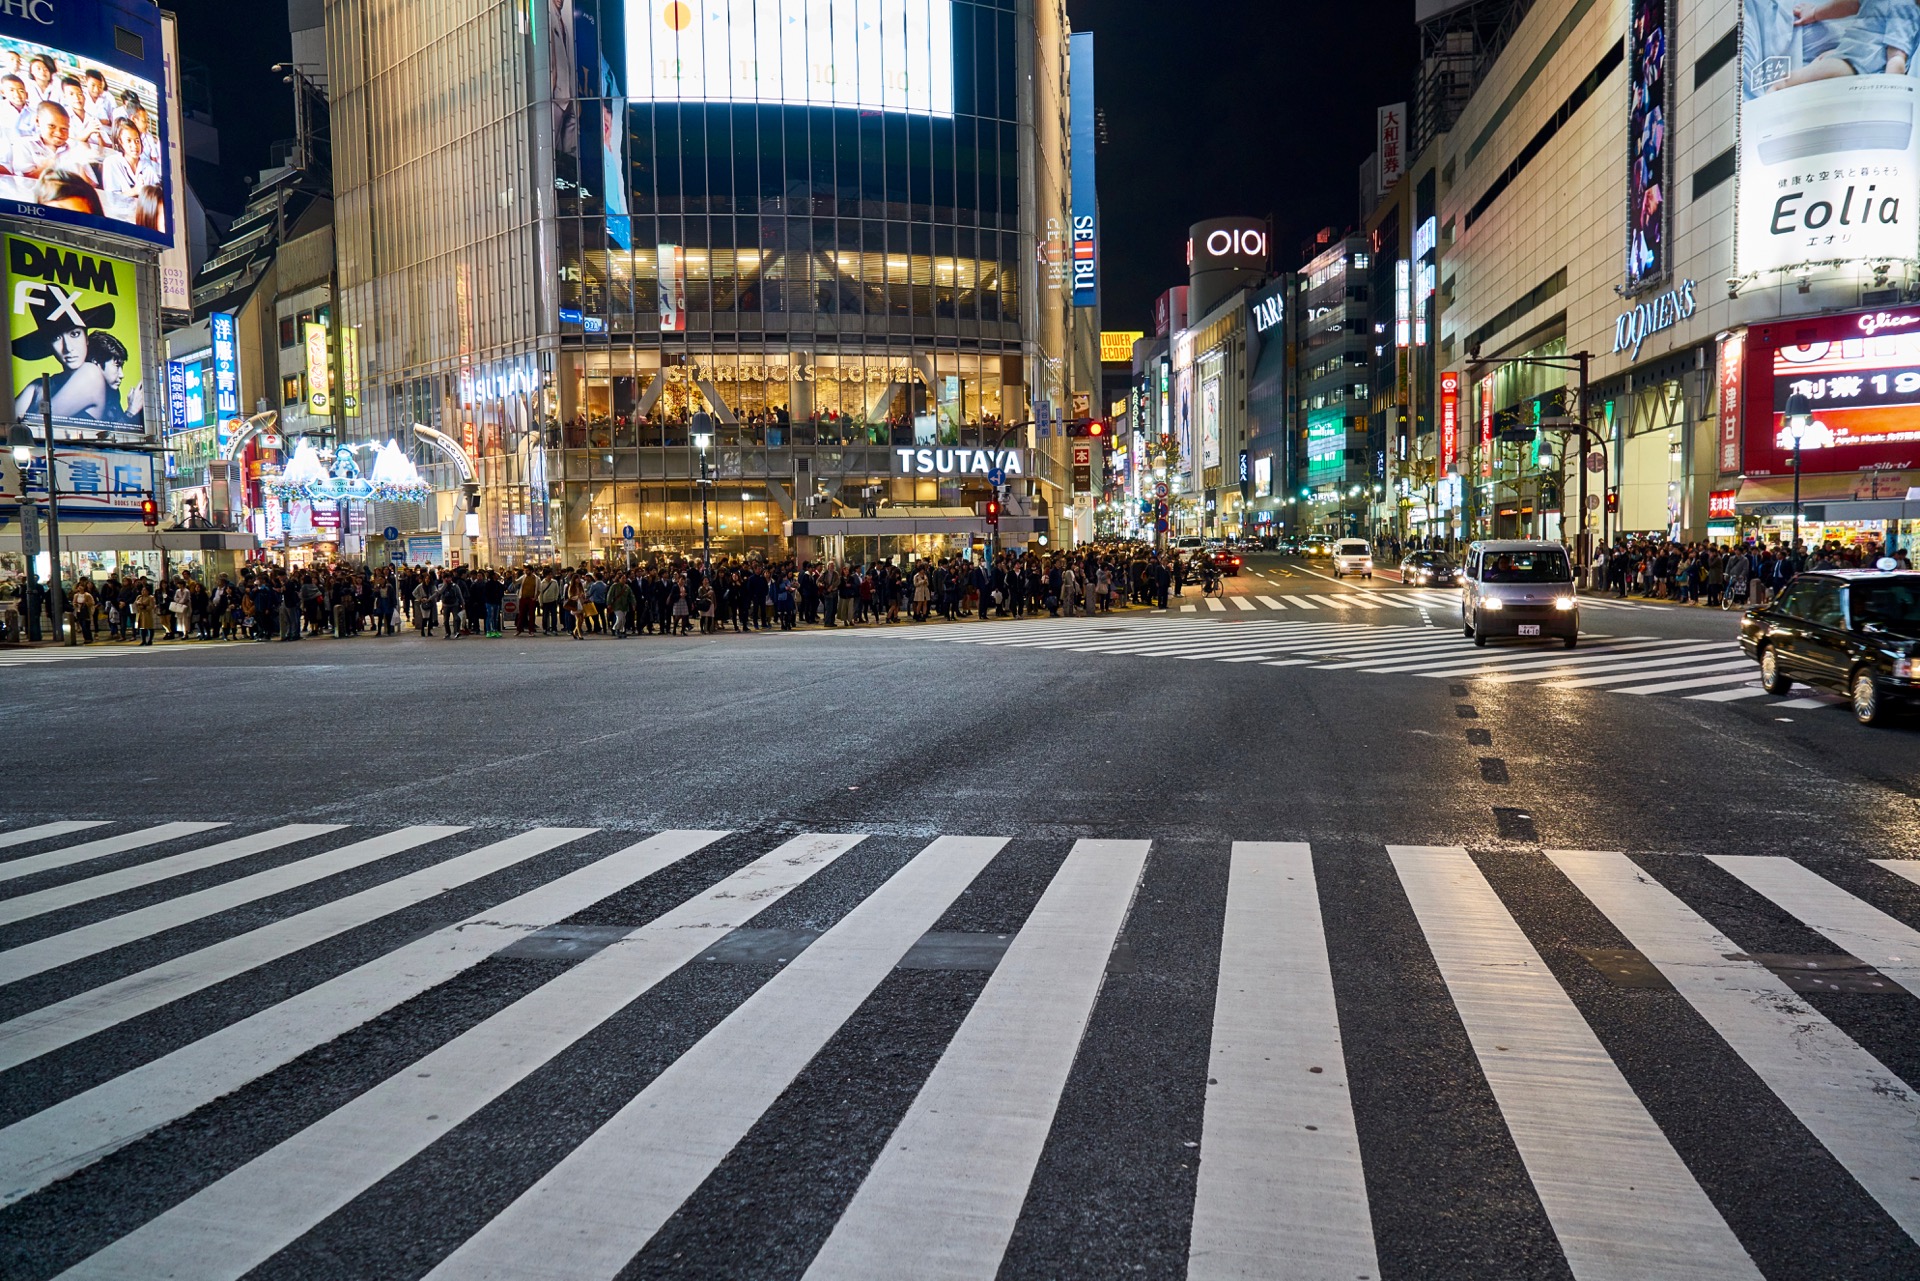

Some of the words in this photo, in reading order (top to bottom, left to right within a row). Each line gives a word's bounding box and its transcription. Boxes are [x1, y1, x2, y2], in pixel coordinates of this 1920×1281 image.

[0, 0, 54, 24] HC
[1778, 167, 1899, 188] 健康な空気と暮らそう
[17, 203, 46, 217] DHC
[1770, 184, 1899, 235] Eolia
[1074, 215, 1095, 290] SEIBU
[9, 237, 119, 297] DMM
[164, 268, 183, 278] (03)
[163, 277, 184, 287] 3719
[164, 285, 185, 296] 2468
[13, 280, 86, 327] FX
[1253, 293, 1284, 332] ZARA
[1858, 312, 1920, 335] Glico
[1101, 334, 1131, 346] TOWER
[214, 318, 237, 411] 洋服の青山
[668, 363, 818, 382] STARBUCKS
[833, 365, 920, 383] COFFEE
[312, 395, 326, 405] 4F
[1723, 341, 1741, 468] 天津甘栗
[896, 449, 1022, 474] TSUTAYA
[1076, 451, 1088, 463] 本
[267, 500, 276, 531] ラーメン
